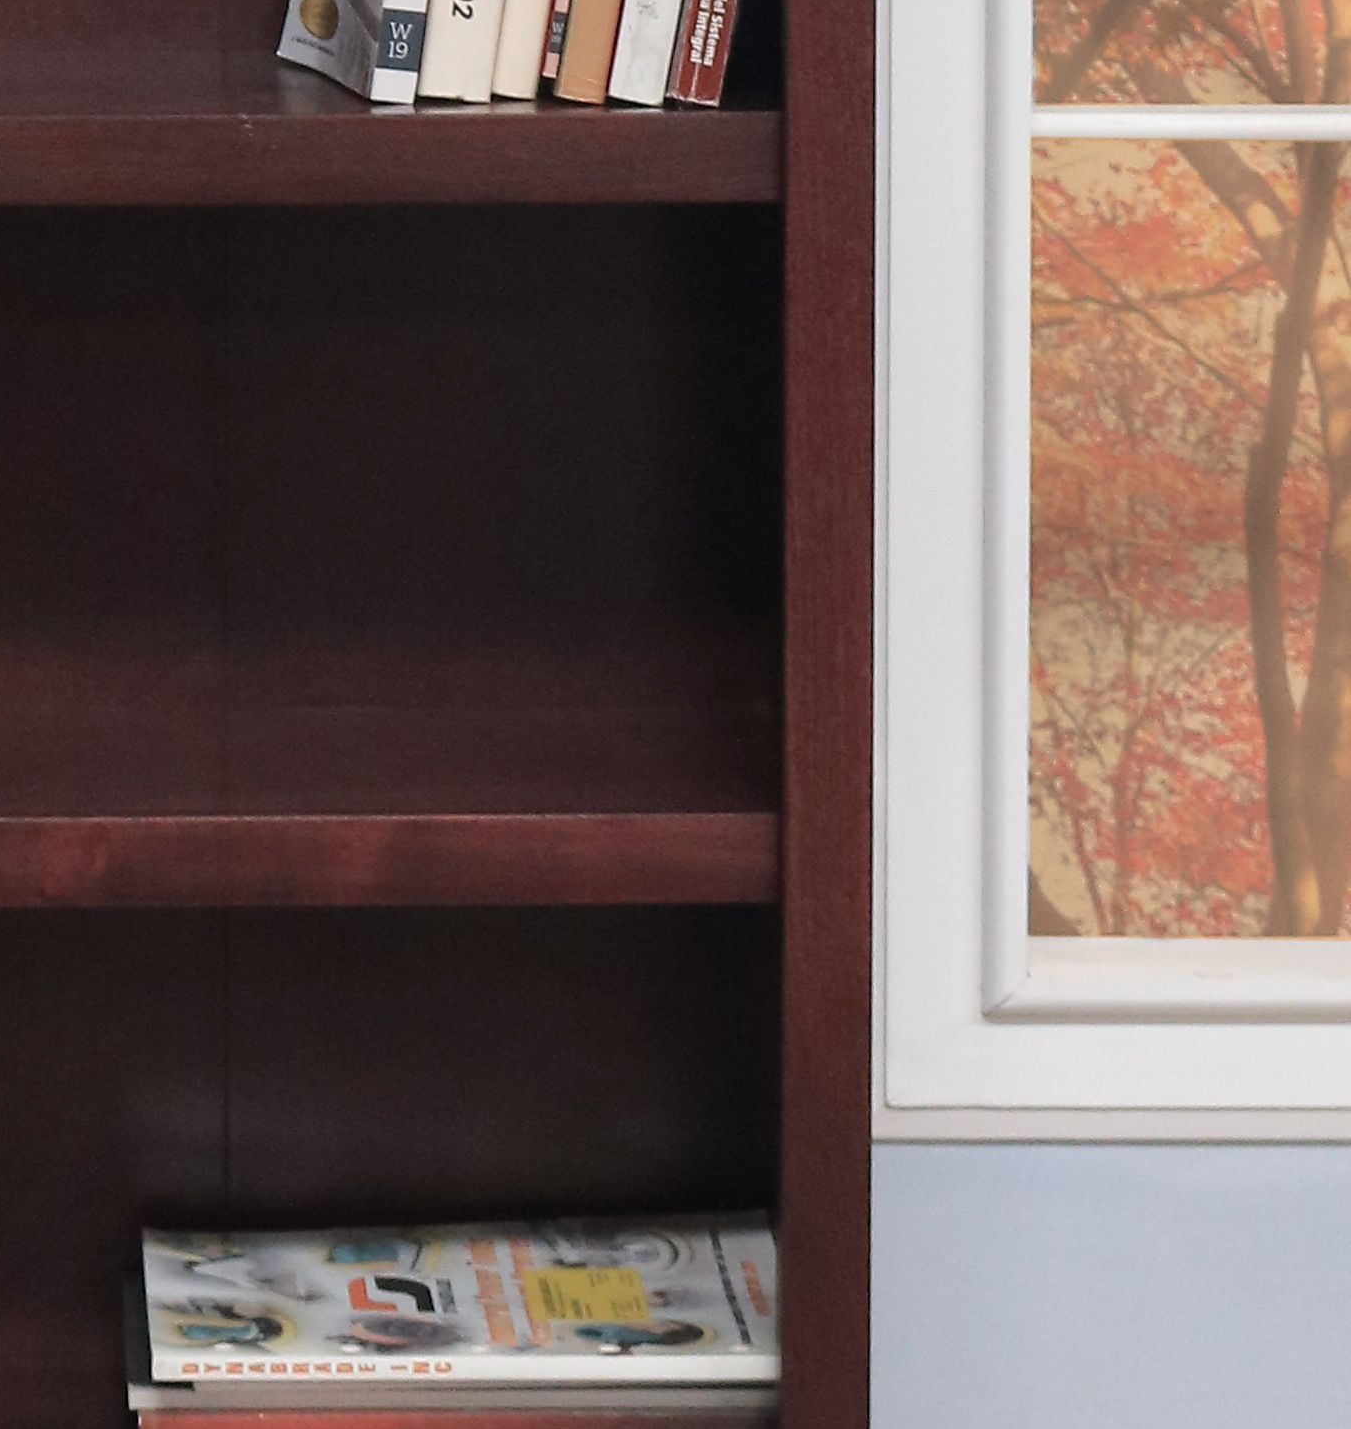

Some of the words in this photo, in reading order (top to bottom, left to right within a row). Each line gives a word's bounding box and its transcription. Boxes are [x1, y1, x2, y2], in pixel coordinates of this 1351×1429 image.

[390, 22, 413, 40] W
[690, 11, 709, 64] Integral
[703, 13, 724, 67] Sistema
[387, 41, 408, 58] 19
[181, 1362, 376, 1375] DYNABRADE
[390, 1362, 452, 1375] INC
